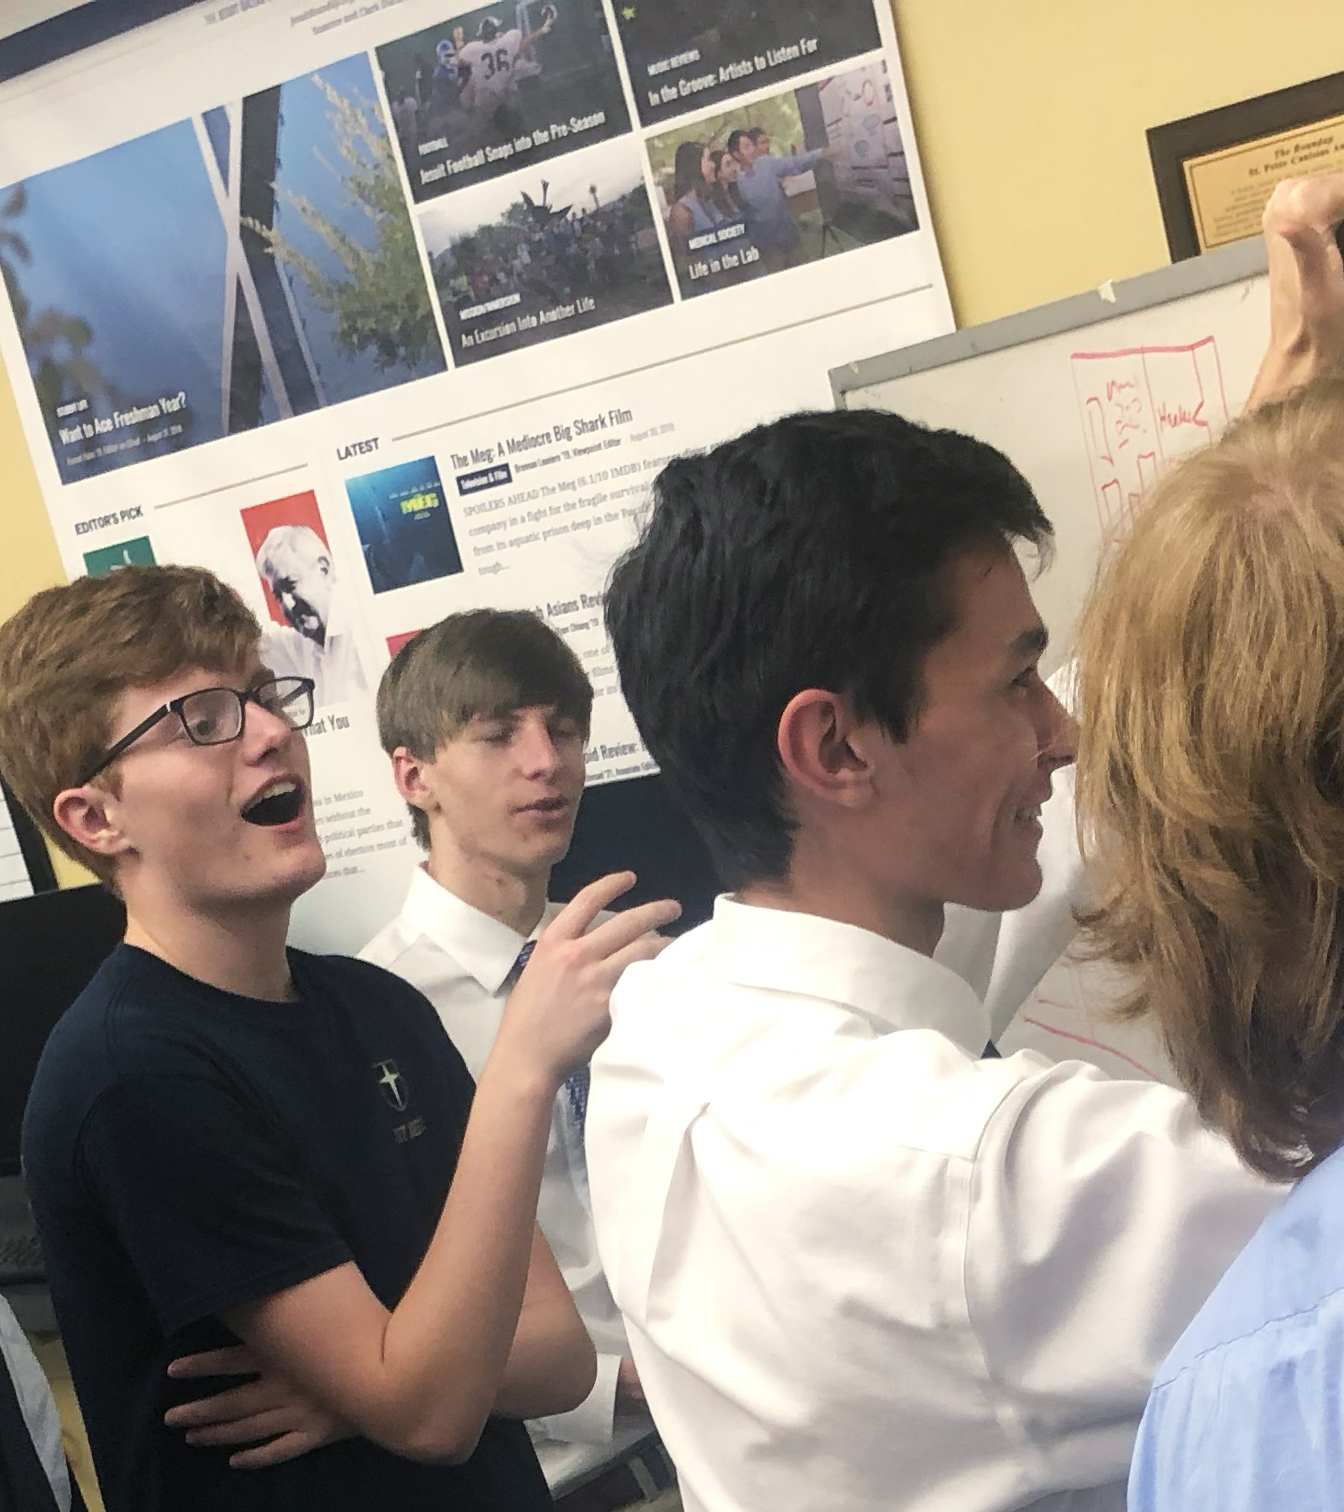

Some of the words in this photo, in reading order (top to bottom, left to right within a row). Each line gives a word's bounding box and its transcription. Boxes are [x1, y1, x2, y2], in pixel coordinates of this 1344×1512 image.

[646, 88, 660, 106] In
[658, 82, 679, 102] the
[715, 56, 754, 83] Artists
[753, 53, 767, 70] to
[765, 41, 800, 66] Listen
[798, 34, 820, 55] For
[444, 148, 486, 174] Football
[512, 133, 532, 151] into
[530, 126, 550, 145] the
[548, 108, 607, 139] Pre-Season
[686, 259, 709, 279] Life
[720, 250, 740, 269] the
[738, 244, 760, 264] Lab
[459, 331, 474, 348] An
[473, 318, 517, 344] Excursion
[515, 311, 538, 330] Into
[536, 301, 576, 325] Another
[575, 294, 596, 314] Life
[58, 423, 83, 445] Want
[81, 421, 94, 438] to
[91, 413, 113, 434] Ace
[111, 399, 161, 429] Freshman
[157, 390, 189, 414] Year?
[450, 451, 469, 470] The
[468, 443, 496, 467] Meg:
[495, 441, 505, 457] A
[505, 427, 553, 454] Mediocre
[552, 422, 573, 444] Big
[572, 411, 607, 436] Shark
[607, 404, 633, 426] Film
[336, 437, 381, 461] LATEST
[462, 497, 506, 517] SPOILERS
[506, 488, 540, 505] AHEAD
[540, 483, 557, 497] The
[557, 479, 577, 495] Meg
[609, 462, 641, 479] IMDB)
[561, 499, 577, 512] the
[73, 512, 119, 535] EDITOR'S
[119, 505, 143, 522] PICK
[545, 596, 579, 618] Asians
[579, 589, 606, 610] Revi
[327, 714, 350, 731] You
